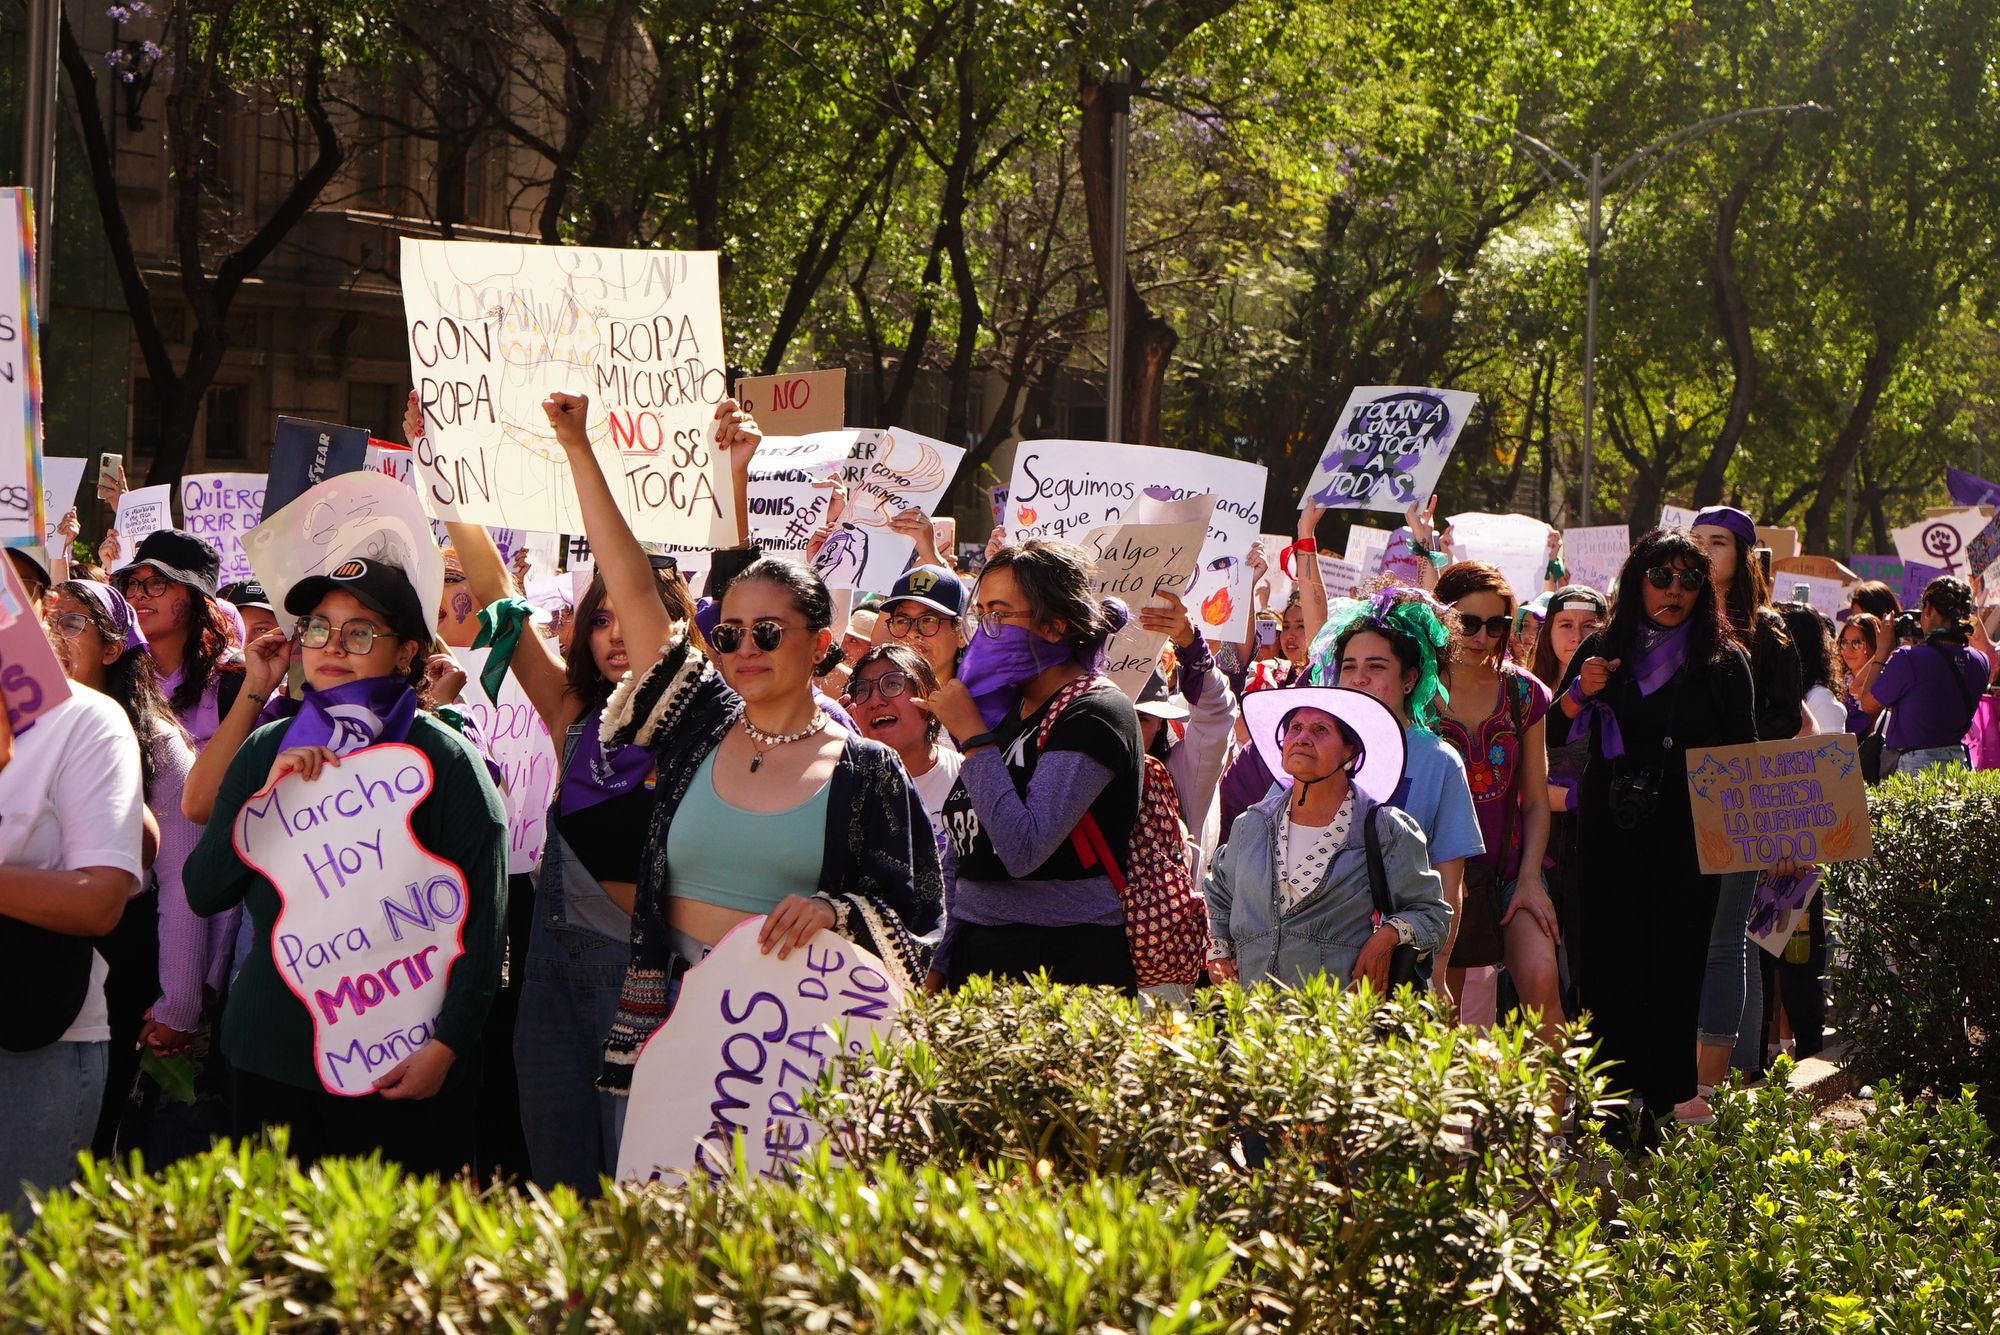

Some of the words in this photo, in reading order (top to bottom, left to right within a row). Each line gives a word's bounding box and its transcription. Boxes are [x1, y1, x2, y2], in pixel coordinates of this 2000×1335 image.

[412, 317, 491, 367] CON
[611, 315, 699, 362] ROPA
[420, 374, 495, 430] ROPA
[770, 379, 810, 411] NO
[1354, 400, 1422, 420] TOCAN
[1426, 404, 1443, 422] A
[610, 411, 663, 451] NO
[672, 428, 709, 468] SE
[754, 444, 820, 457] ARZO
[1334, 432, 1374, 452] NOS
[1378, 434, 1443, 456] TOCAN
[314, 433, 330, 483] YEAR
[432, 447, 490, 504] SIN
[1364, 453, 1385, 472] A
[626, 464, 723, 518] TOCA
[1016, 454, 1134, 511] Seguimos
[1325, 472, 1412, 500] TODAS
[1093, 533, 1160, 571] Salgo
[1164, 544, 1183, 568] y
[1728, 757, 1753, 783] SI
[1759, 750, 1816, 779] KAREN
[243, 766, 425, 853] Marcho
[1720, 787, 1744, 812] NO
[1750, 779, 1823, 809] REGRESA
[1724, 812, 1749, 836] LO
[1753, 802, 1838, 834] QUEMAMOS
[1732, 831, 1817, 864] TODO
[279, 926, 371, 984] Para
[380, 874, 466, 942] NO
[798, 943, 844, 1001] DE
[839, 965, 889, 1021] NO
